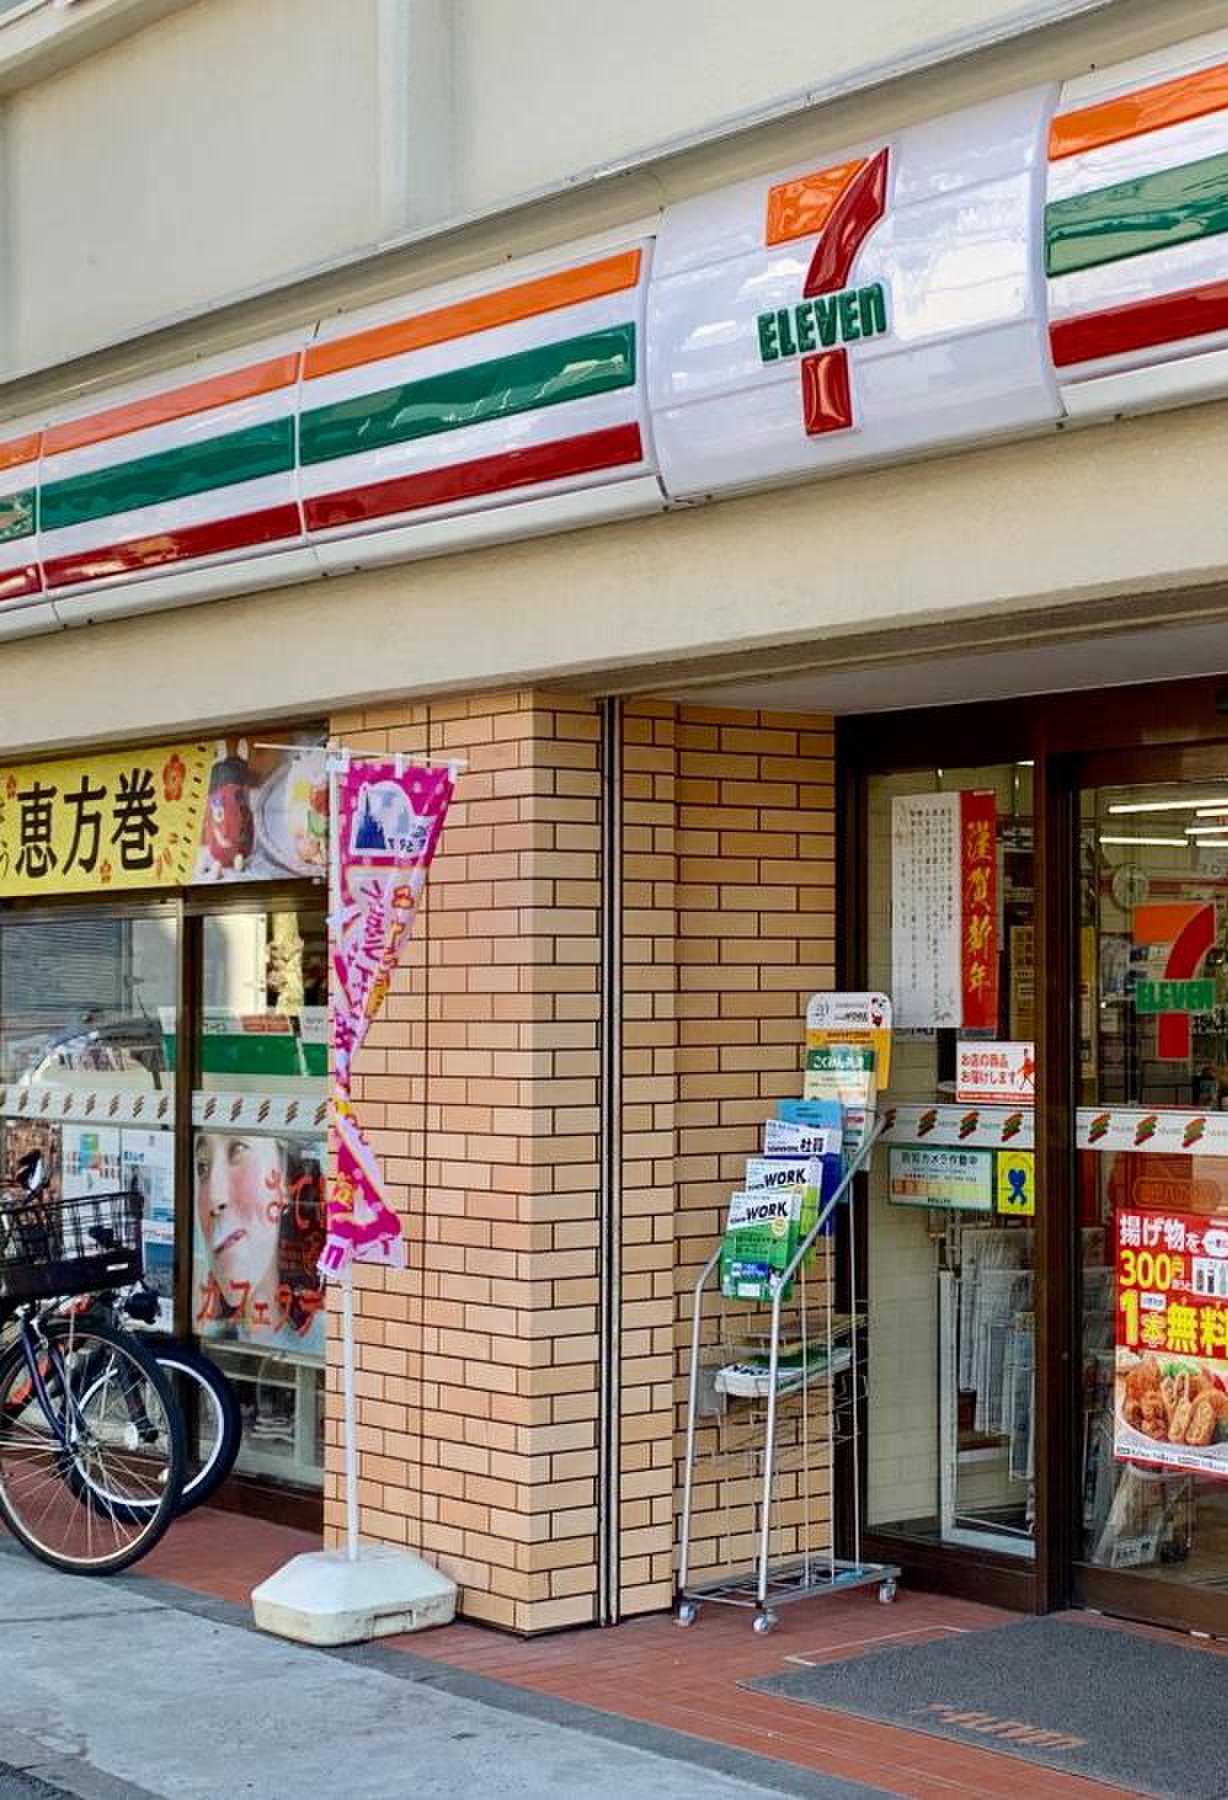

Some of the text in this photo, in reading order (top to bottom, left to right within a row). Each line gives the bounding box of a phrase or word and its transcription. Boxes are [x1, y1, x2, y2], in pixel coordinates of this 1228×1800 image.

[15, 767, 159, 879] 恵方巻
[764, 1168, 807, 1187] WORK
[745, 1201, 789, 1221] WORK
